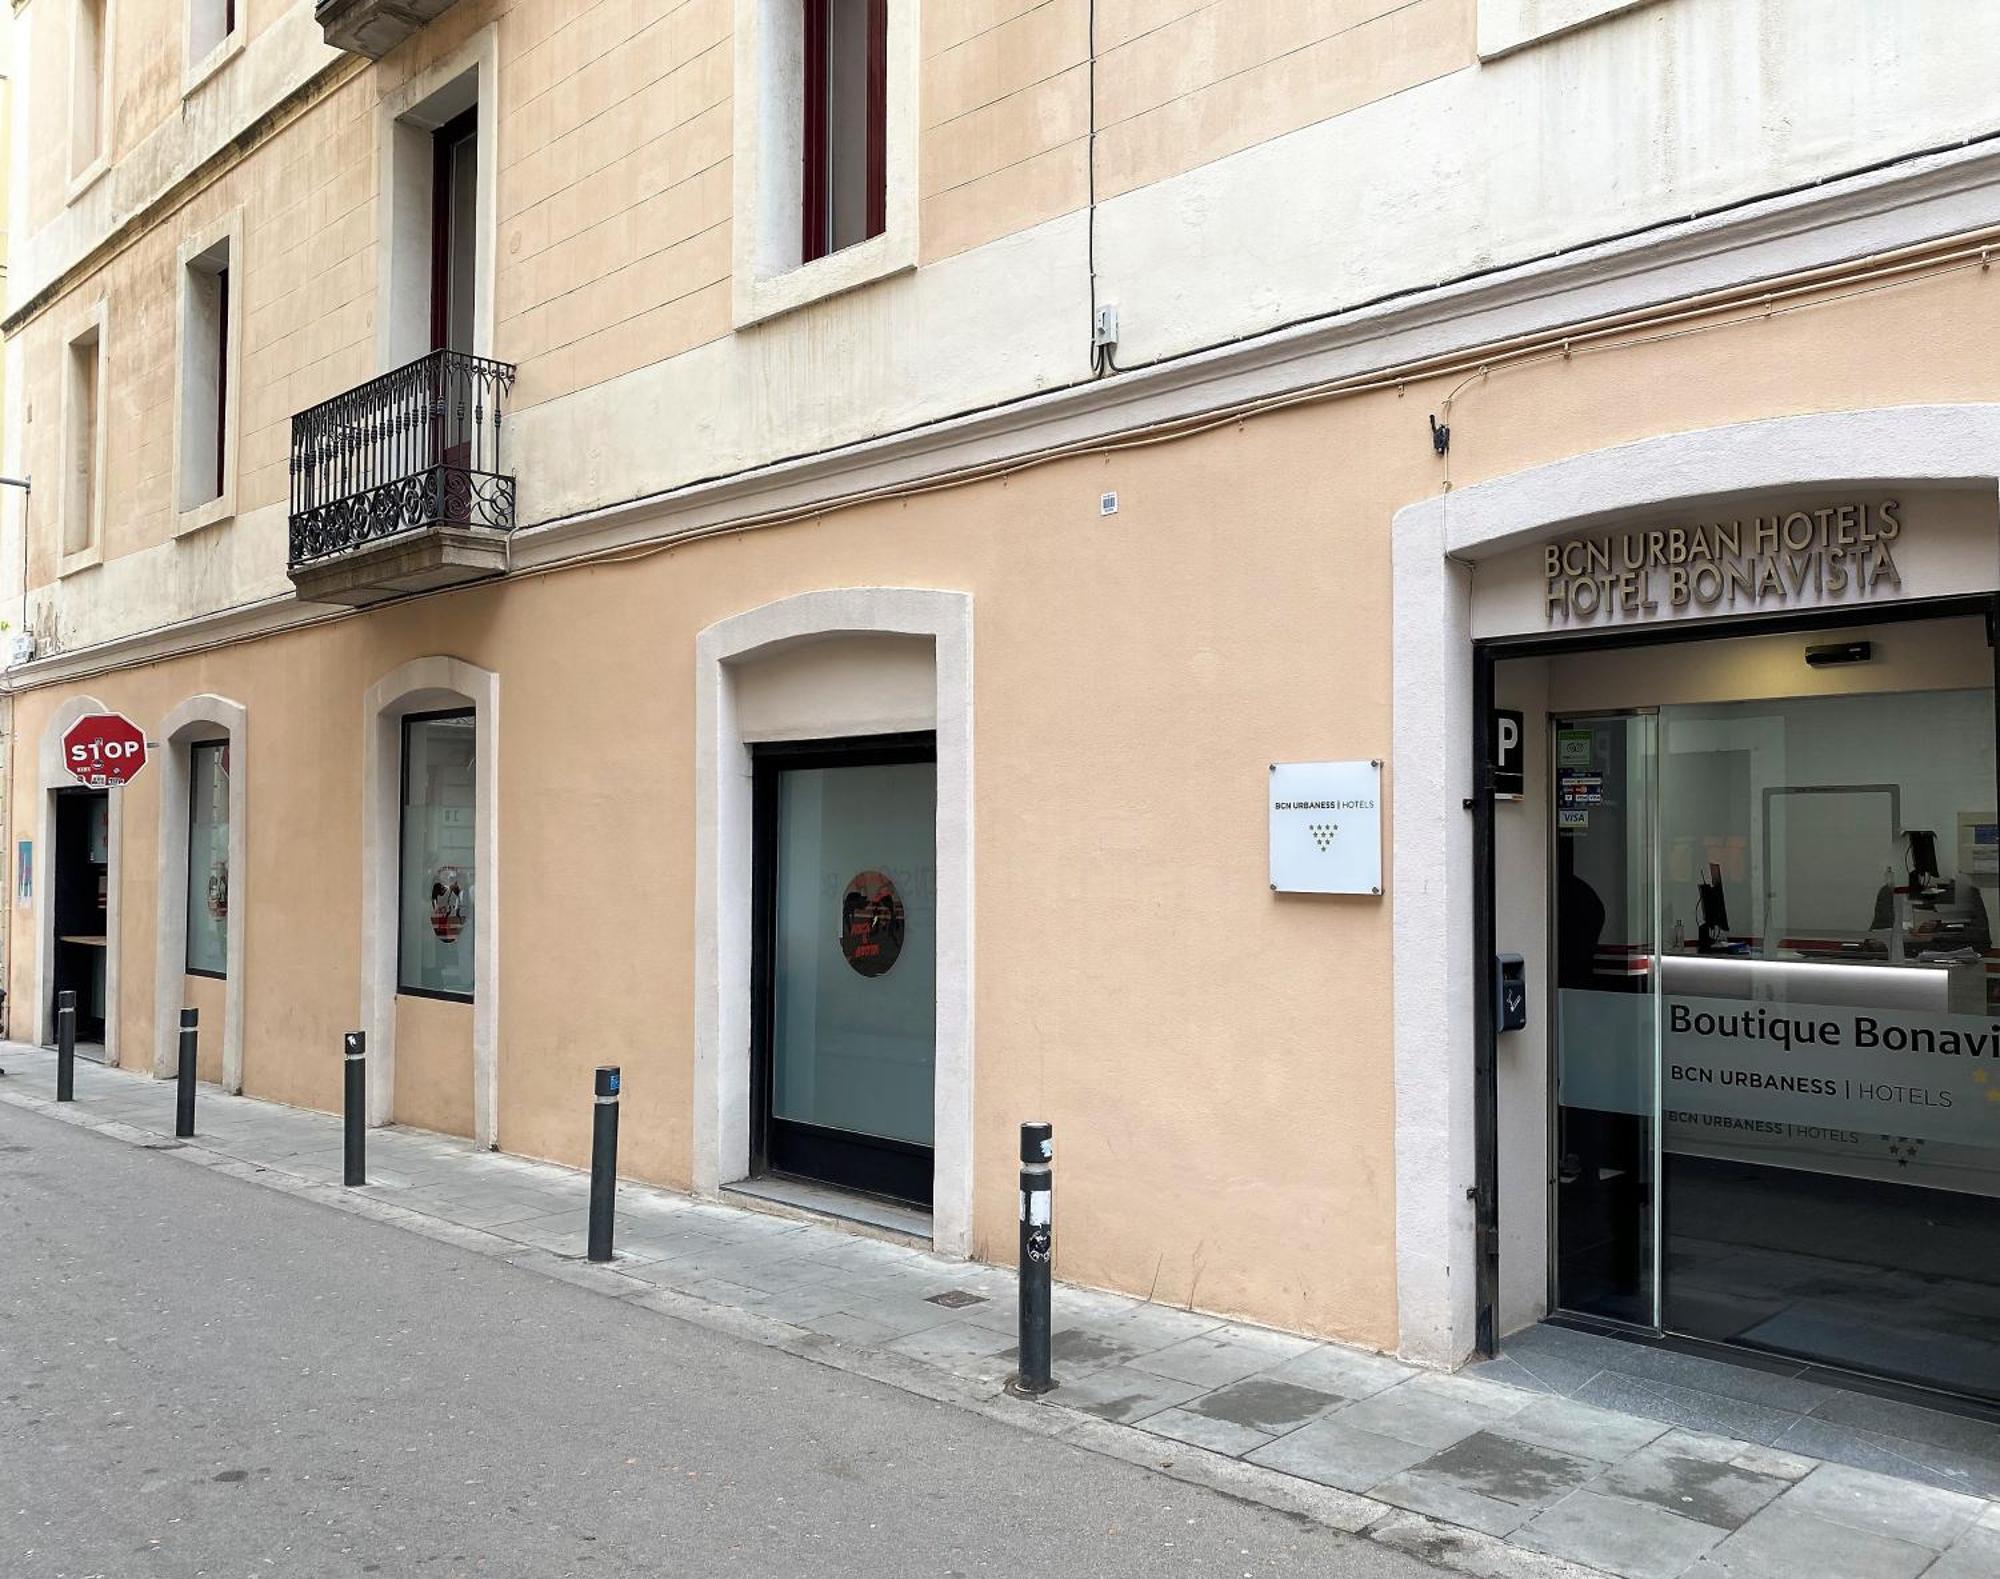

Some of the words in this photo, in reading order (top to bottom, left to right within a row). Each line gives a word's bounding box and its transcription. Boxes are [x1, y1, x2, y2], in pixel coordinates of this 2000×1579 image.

[1544, 537, 1612, 579] BCN
[1622, 520, 1741, 569] URBAN
[1755, 500, 1900, 554] HOTELS
[1545, 570, 1659, 617] HOTEL
[1671, 542, 1902, 606] BONAVISTA
[71, 740, 140, 761] STOP
[1498, 718, 1518, 766] P
[1275, 802, 1291, 810] BCN
[1293, 801, 1335, 809] URBANESS
[1342, 800, 1374, 809] HOTELS
[1564, 813, 1585, 822] VISA
[1670, 1003, 1841, 1051] Boutique
[1855, 1016, 2000, 1058] Bonavi
[1671, 1065, 1713, 1084] BCN
[1720, 1070, 1837, 1096] URBANESS
[1859, 1082, 1953, 1108] HOTELS
[1668, 1110, 1698, 1125] BCN
[1703, 1115, 1783, 1135] URBANESS
[1799, 1125, 1859, 1144] HOTELS
